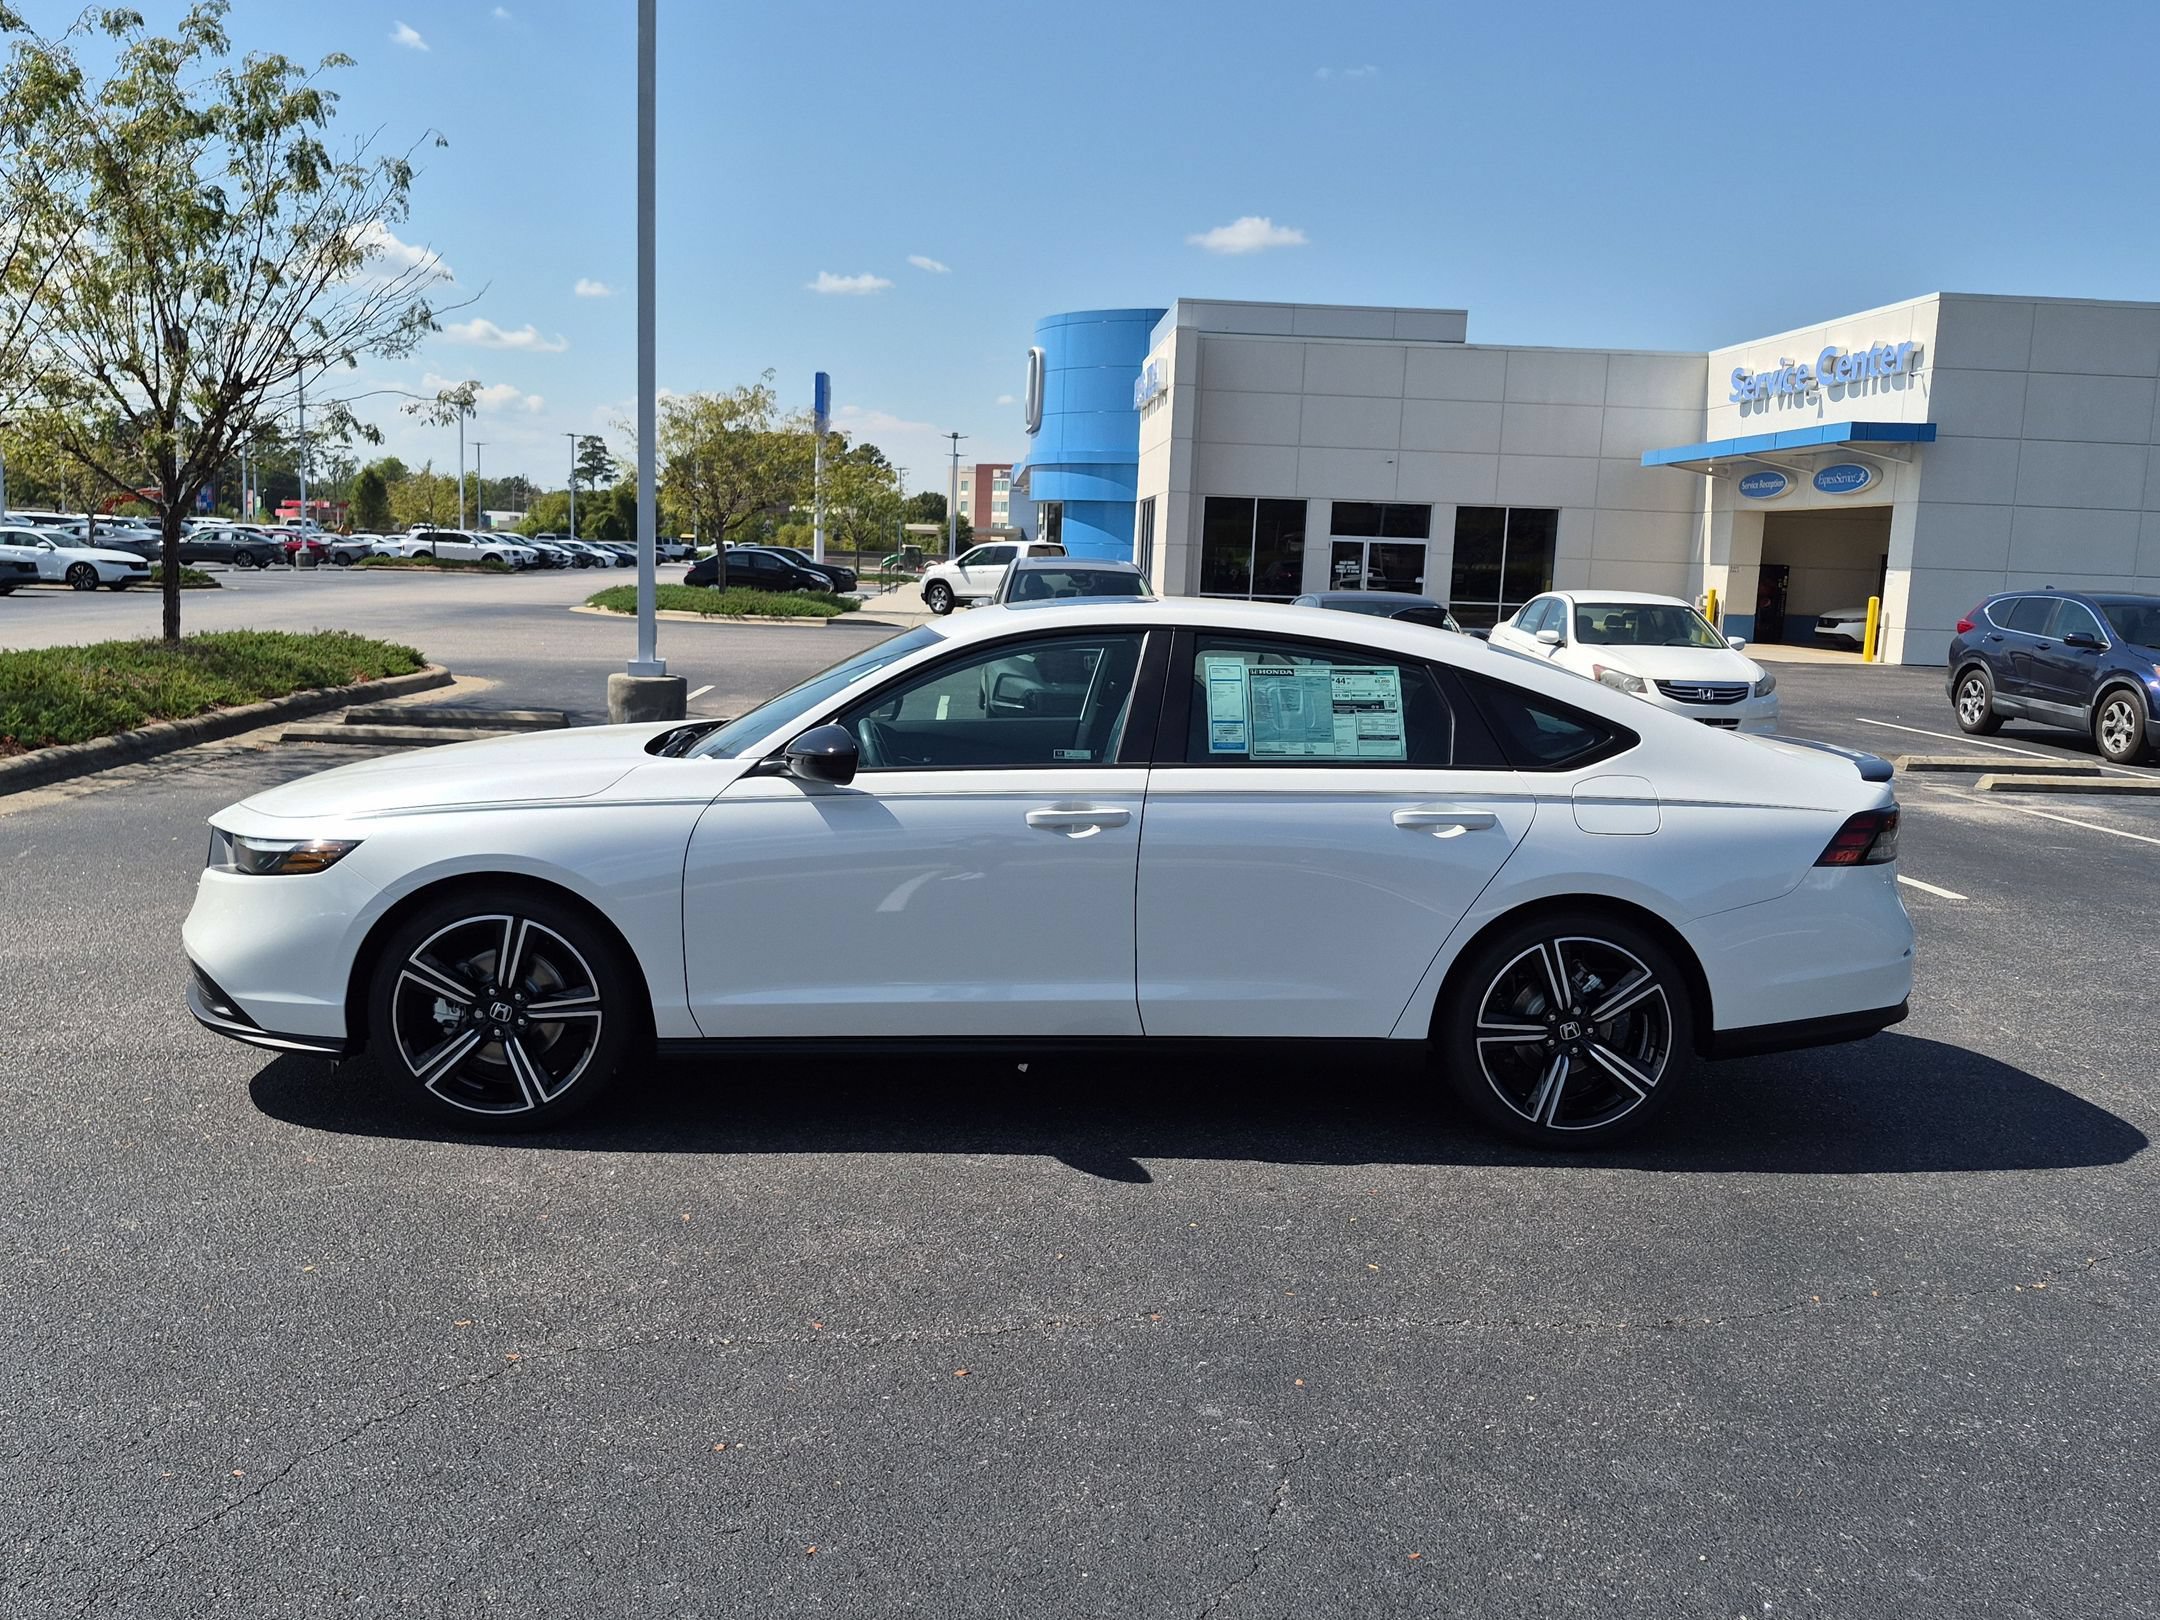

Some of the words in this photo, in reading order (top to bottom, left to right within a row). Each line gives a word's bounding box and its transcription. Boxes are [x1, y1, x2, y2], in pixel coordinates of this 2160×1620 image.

[1729, 357, 1810, 403] Service
[1815, 341, 1914, 386] Center
[1741, 480, 1759, 490] Service
[1759, 478, 1784, 490] Reception
